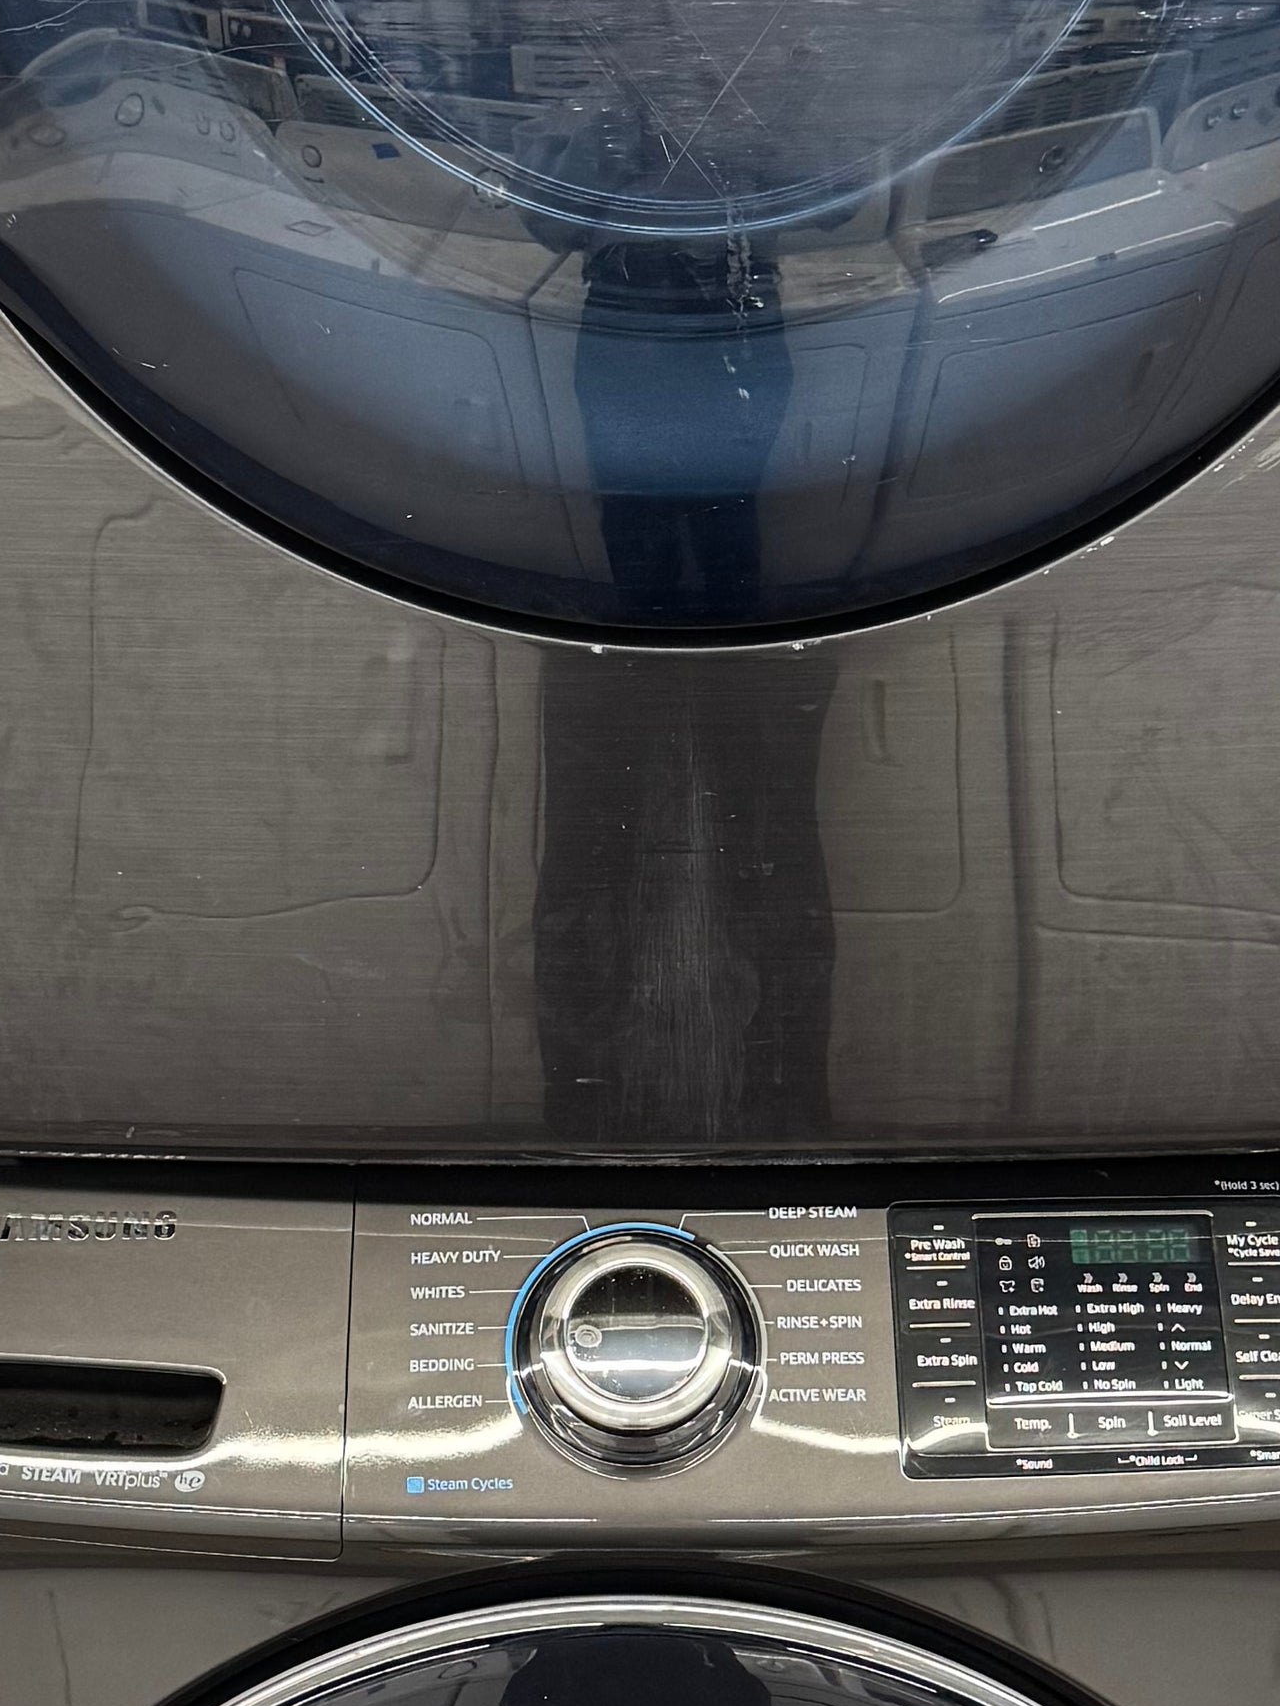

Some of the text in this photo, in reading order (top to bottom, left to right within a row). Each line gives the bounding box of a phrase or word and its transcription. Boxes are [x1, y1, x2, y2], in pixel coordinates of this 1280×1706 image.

[1250, 1181, 1256, 1190] 3
[1260, 1181, 1280, 1191] sec)
[769, 1207, 857, 1218] DEEP STEAM
[410, 1213, 472, 1225] NORMAL
[411, 1250, 500, 1264] HEAVY DUTY
[770, 1245, 859, 1257] QUICK WASH
[787, 1280, 861, 1291] DELICATES
[411, 1287, 465, 1298] WHITES
[909, 1298, 975, 1310] Extra Rinse
[1231, 1293, 1264, 1305] Delay
[410, 1323, 474, 1336] SANITIZE
[780, 1352, 864, 1365] PERM PRESS
[917, 1355, 977, 1366] Extra Spin
[410, 1359, 474, 1372] BEDDING
[769, 1389, 866, 1402] ACTIVE WEAR
[408, 1396, 482, 1409] ALLERGEN
[1098, 1416, 1126, 1428] Spin
[22, 1466, 81, 1484] STEAM
[428, 1477, 513, 1490] Steam Cycles
